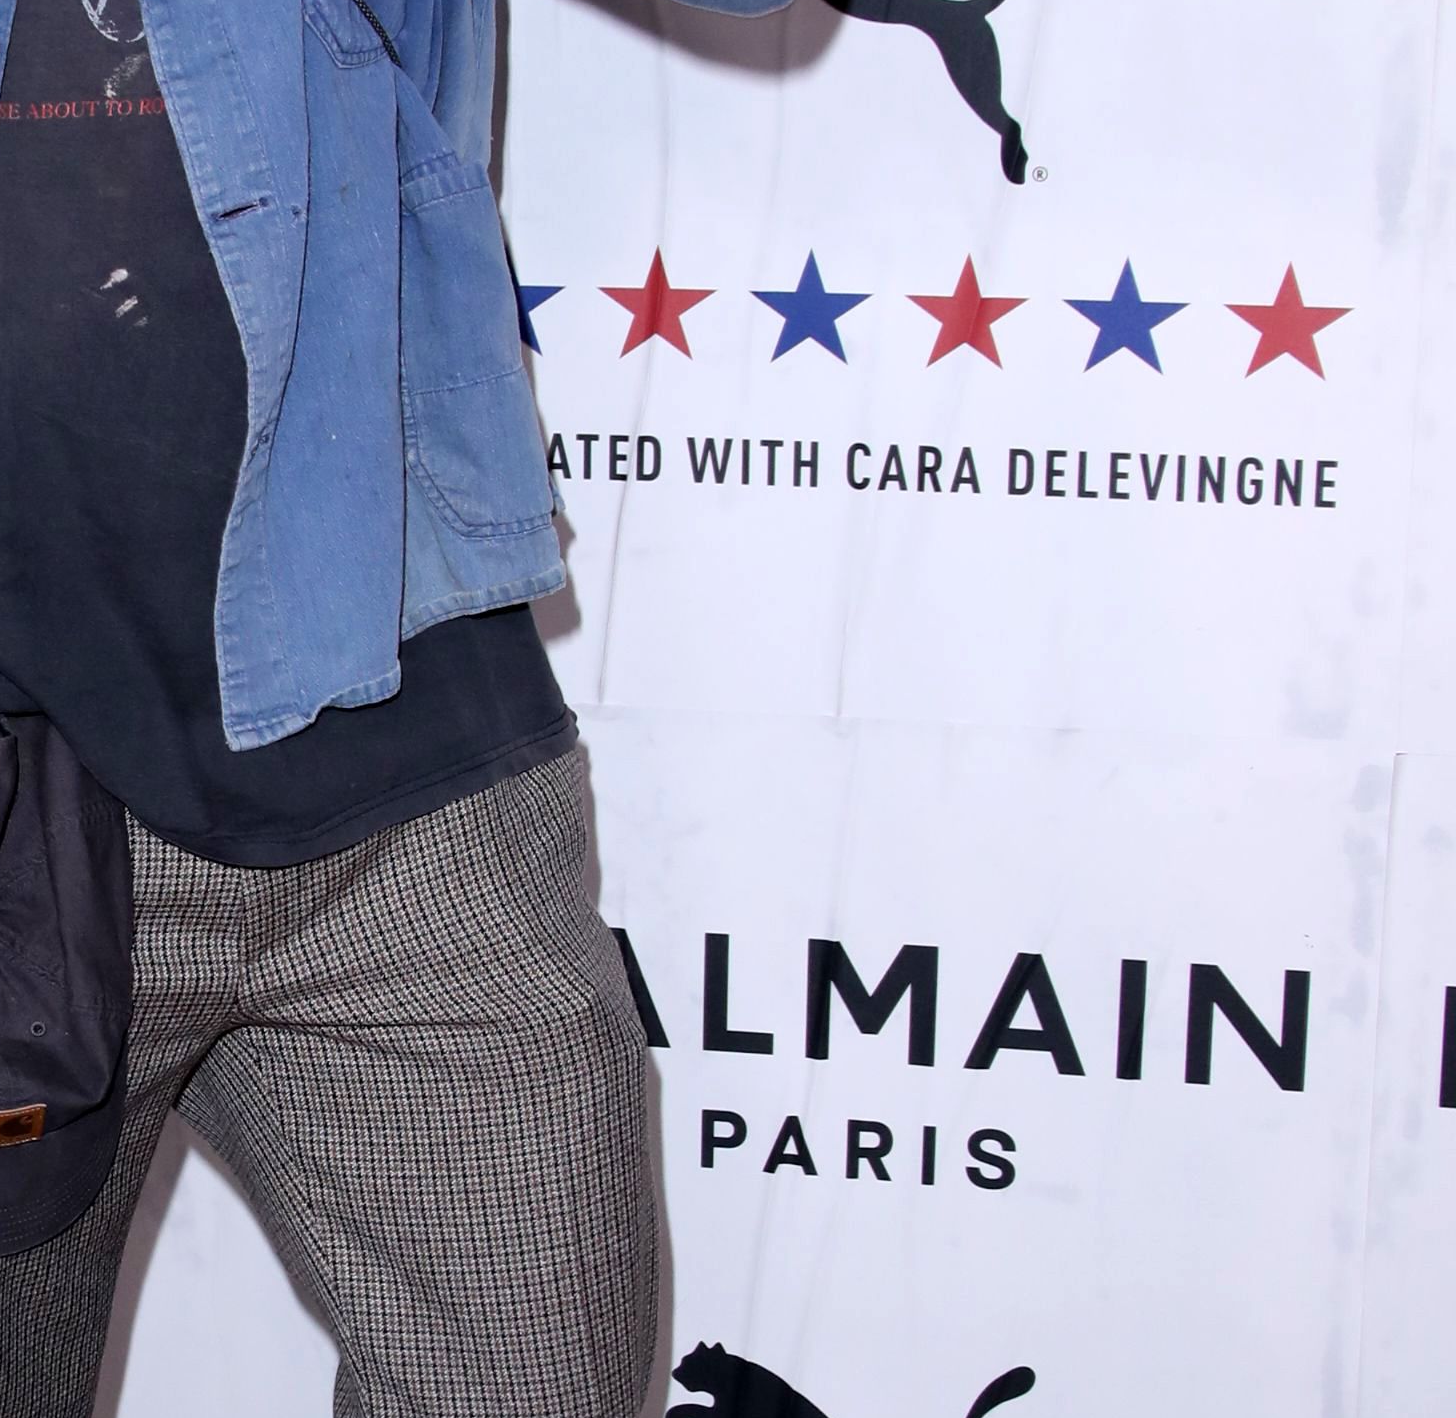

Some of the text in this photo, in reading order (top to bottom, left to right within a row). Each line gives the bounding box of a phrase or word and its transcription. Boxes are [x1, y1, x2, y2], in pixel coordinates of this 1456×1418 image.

[26, 100, 100, 120] ABOUT
[106, 98, 133, 117] TO
[547, 433, 1338, 508] ATED WITH CARA DELEVINGNE
[700, 1109, 1017, 1190] PARIS
